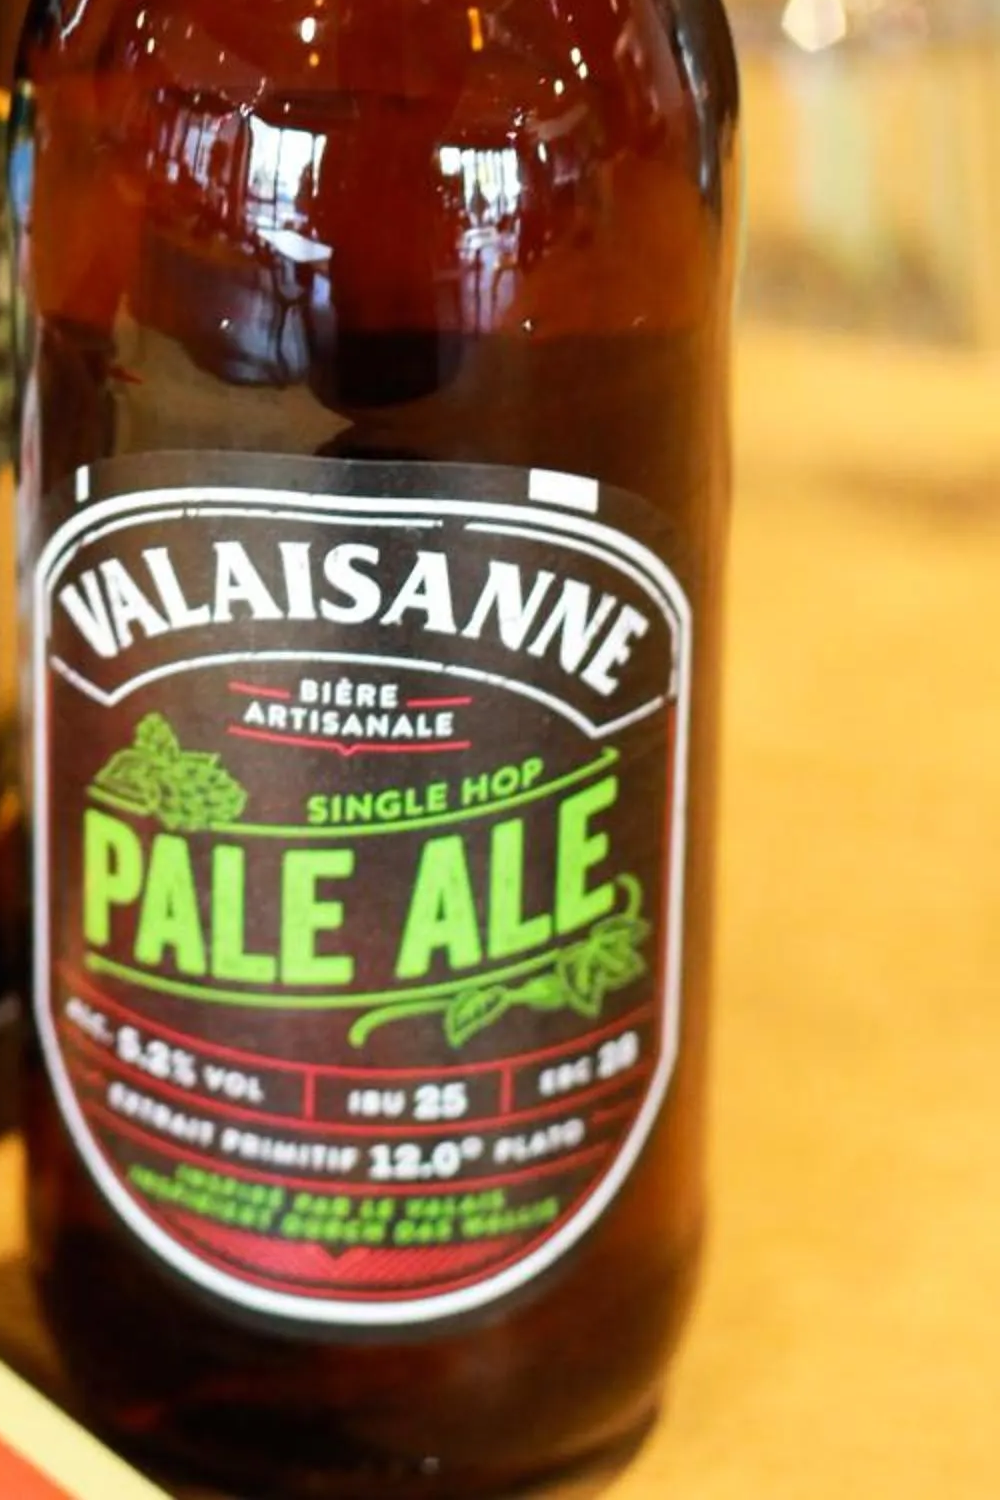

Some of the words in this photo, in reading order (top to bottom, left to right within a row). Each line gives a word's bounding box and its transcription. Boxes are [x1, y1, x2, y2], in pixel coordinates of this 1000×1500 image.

[59, 540, 651, 696] VALAISANNE
[299, 677, 399, 708] BIÈRE
[243, 702, 454, 739] ARTISANALE
[307, 781, 449, 825] SINGLE
[461, 756, 545, 810] HOP
[83, 807, 355, 986] PALE
[395, 775, 618, 980] ALE
[203, 1064, 265, 1103] VOL
[347, 1089, 406, 1118] IBU
[414, 1082, 469, 1121] 25
[221, 1126, 359, 1173] PRIMITIF
